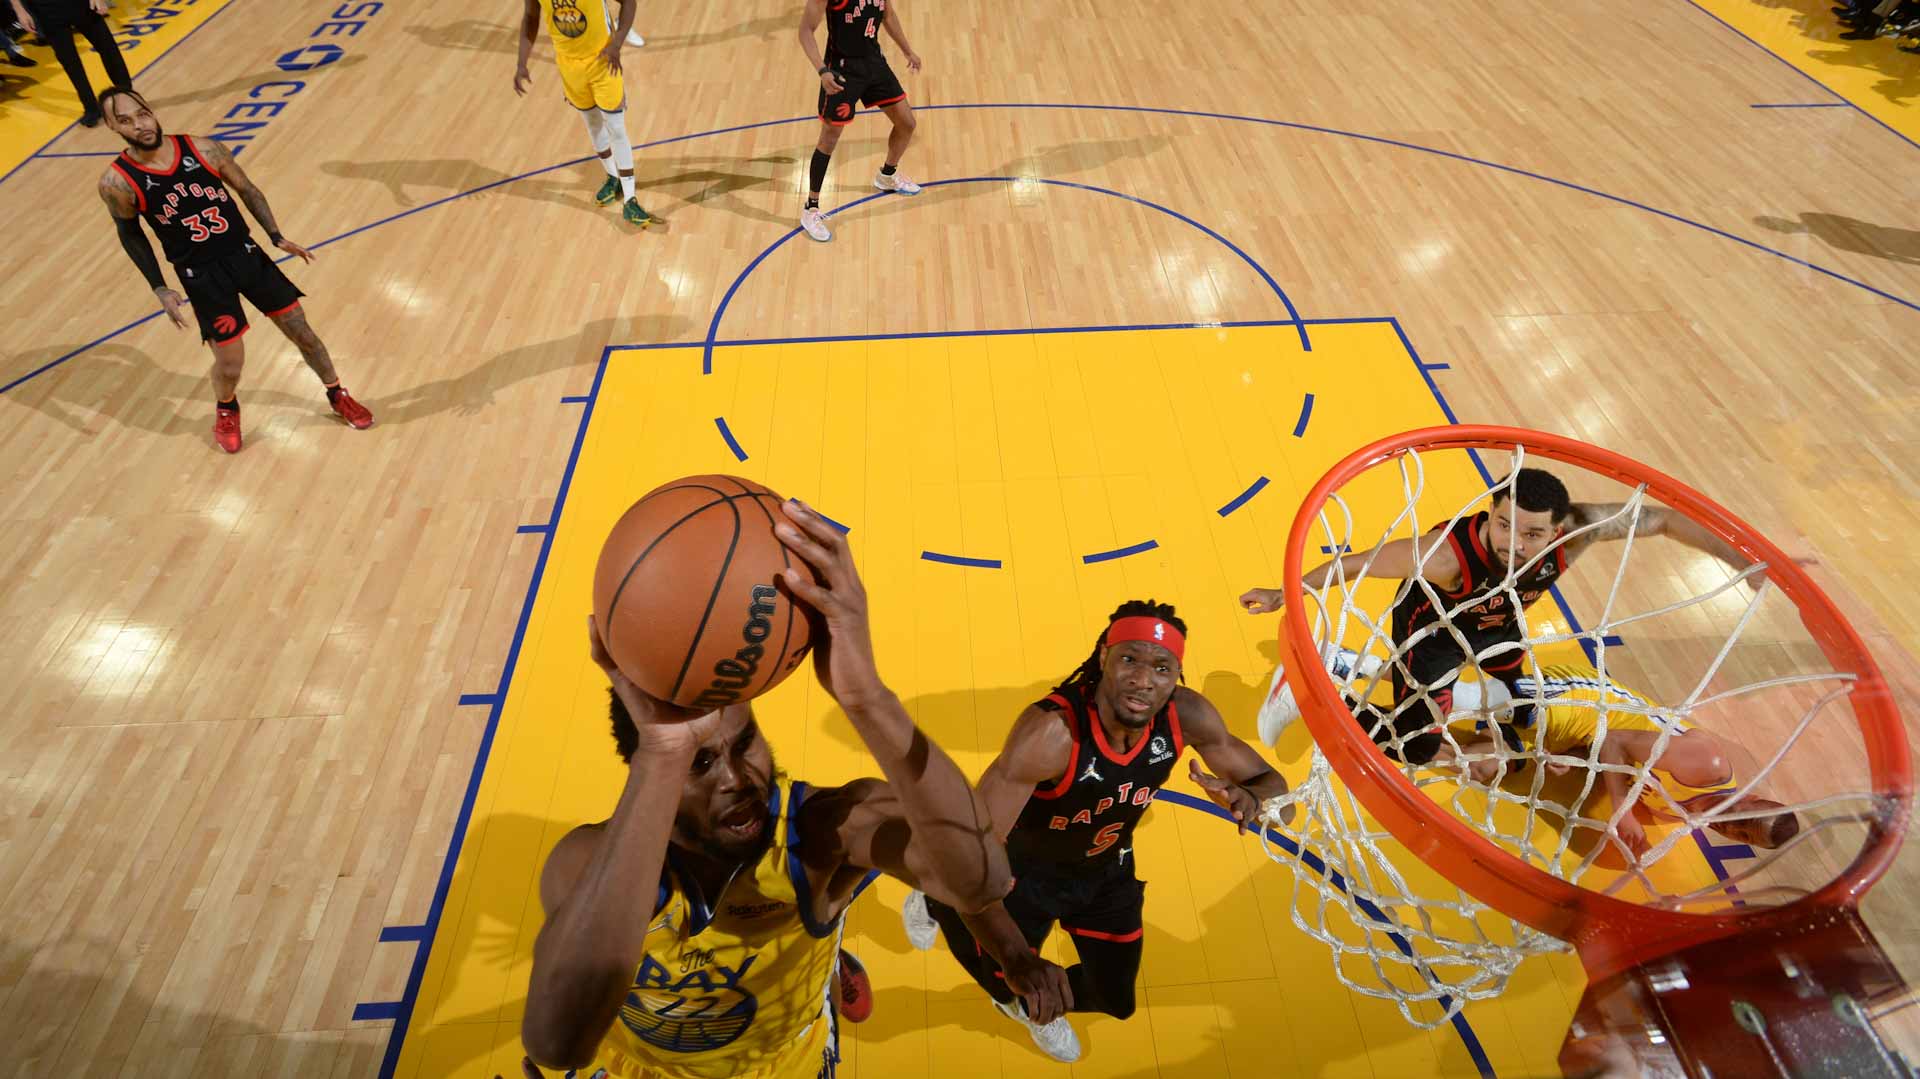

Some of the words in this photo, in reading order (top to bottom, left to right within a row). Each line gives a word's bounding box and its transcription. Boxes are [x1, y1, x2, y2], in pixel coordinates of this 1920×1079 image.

[864, 17, 876, 38] 4
[155, 182, 228, 225] RAPTORS
[181, 206, 229, 242] 33
[1085, 822, 1125, 857] 5
[635, 954, 759, 993] BAY
[680, 948, 714, 973] The
